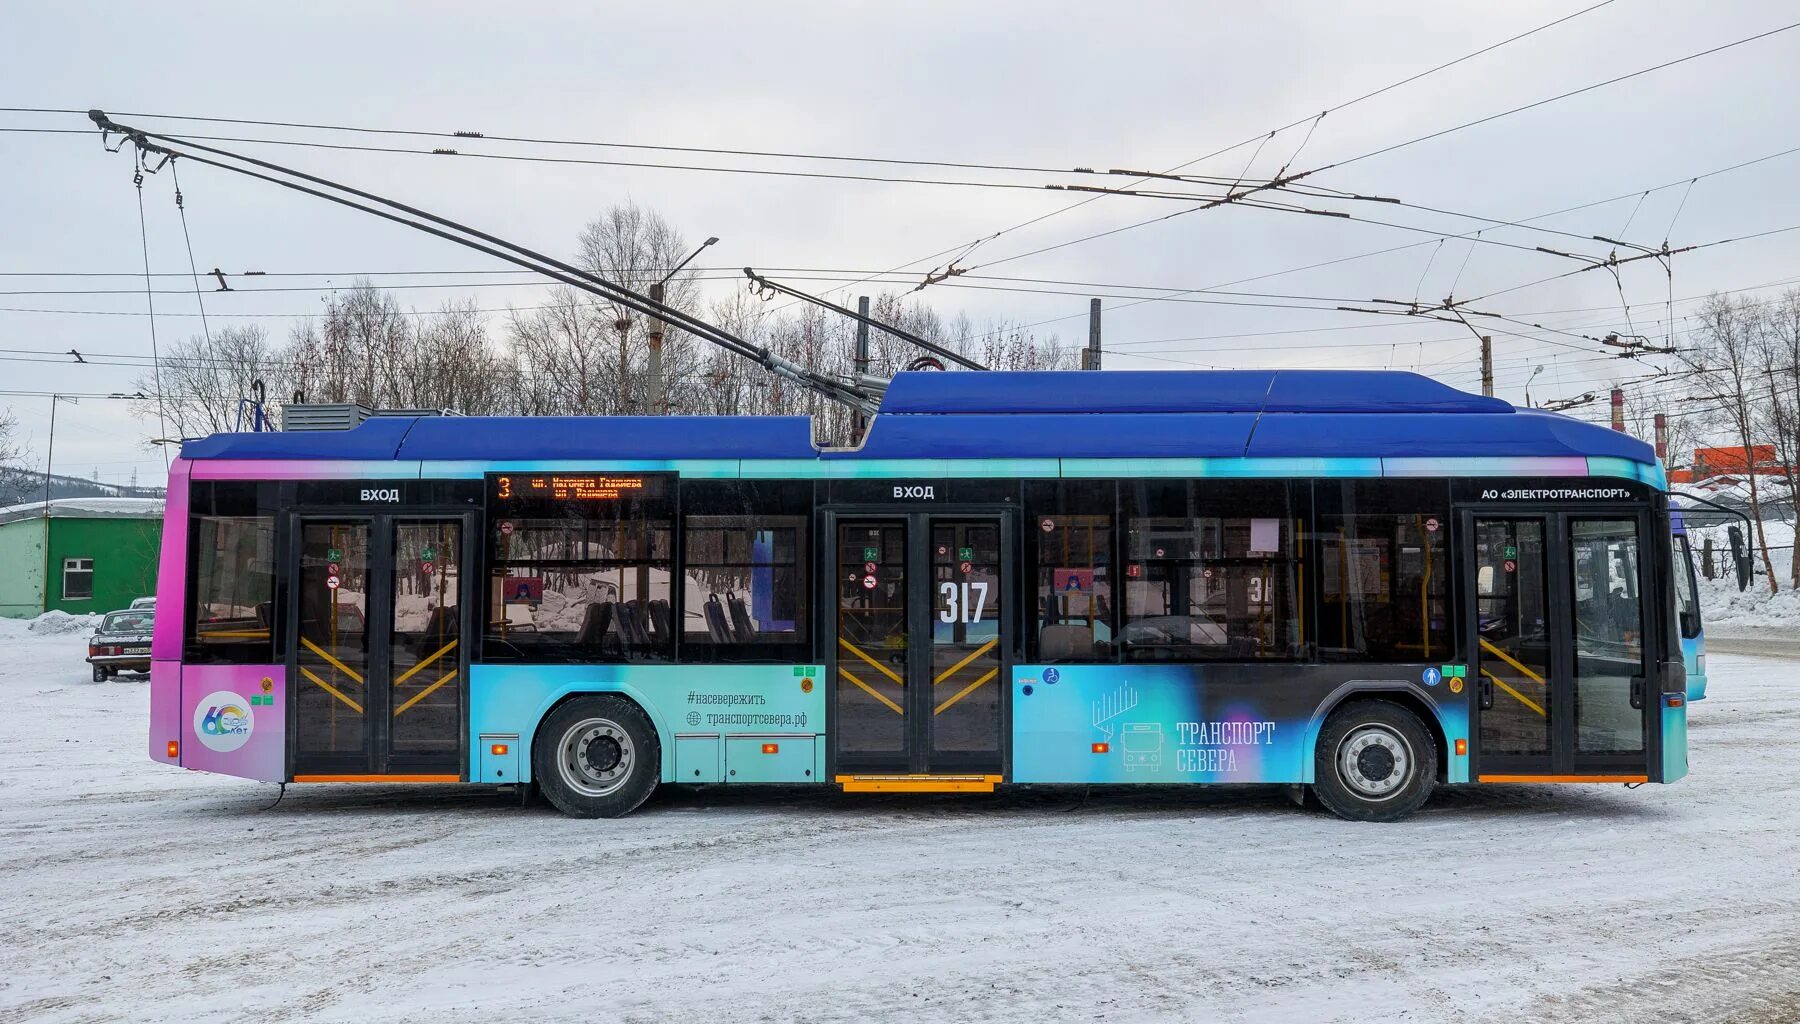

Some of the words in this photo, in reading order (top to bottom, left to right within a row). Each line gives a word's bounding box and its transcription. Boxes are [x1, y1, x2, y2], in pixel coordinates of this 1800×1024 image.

[360, 489, 400, 502] ВХОД
[498, 477, 511, 497] 3
[893, 486, 935, 499] ВХОД
[1481, 489, 1498, 499] АО
[1501, 488, 1631, 499] «ЭЛЕКТРОТРАНСПОРТ»
[940, 581, 988, 624] 317
[687, 690, 766, 707] #насевережить
[706, 711, 808, 727] транспортсевера.рф
[1176, 721, 1275, 745] ТРАНСПОРТ
[1176, 749, 1238, 772] СЕВЕРА
